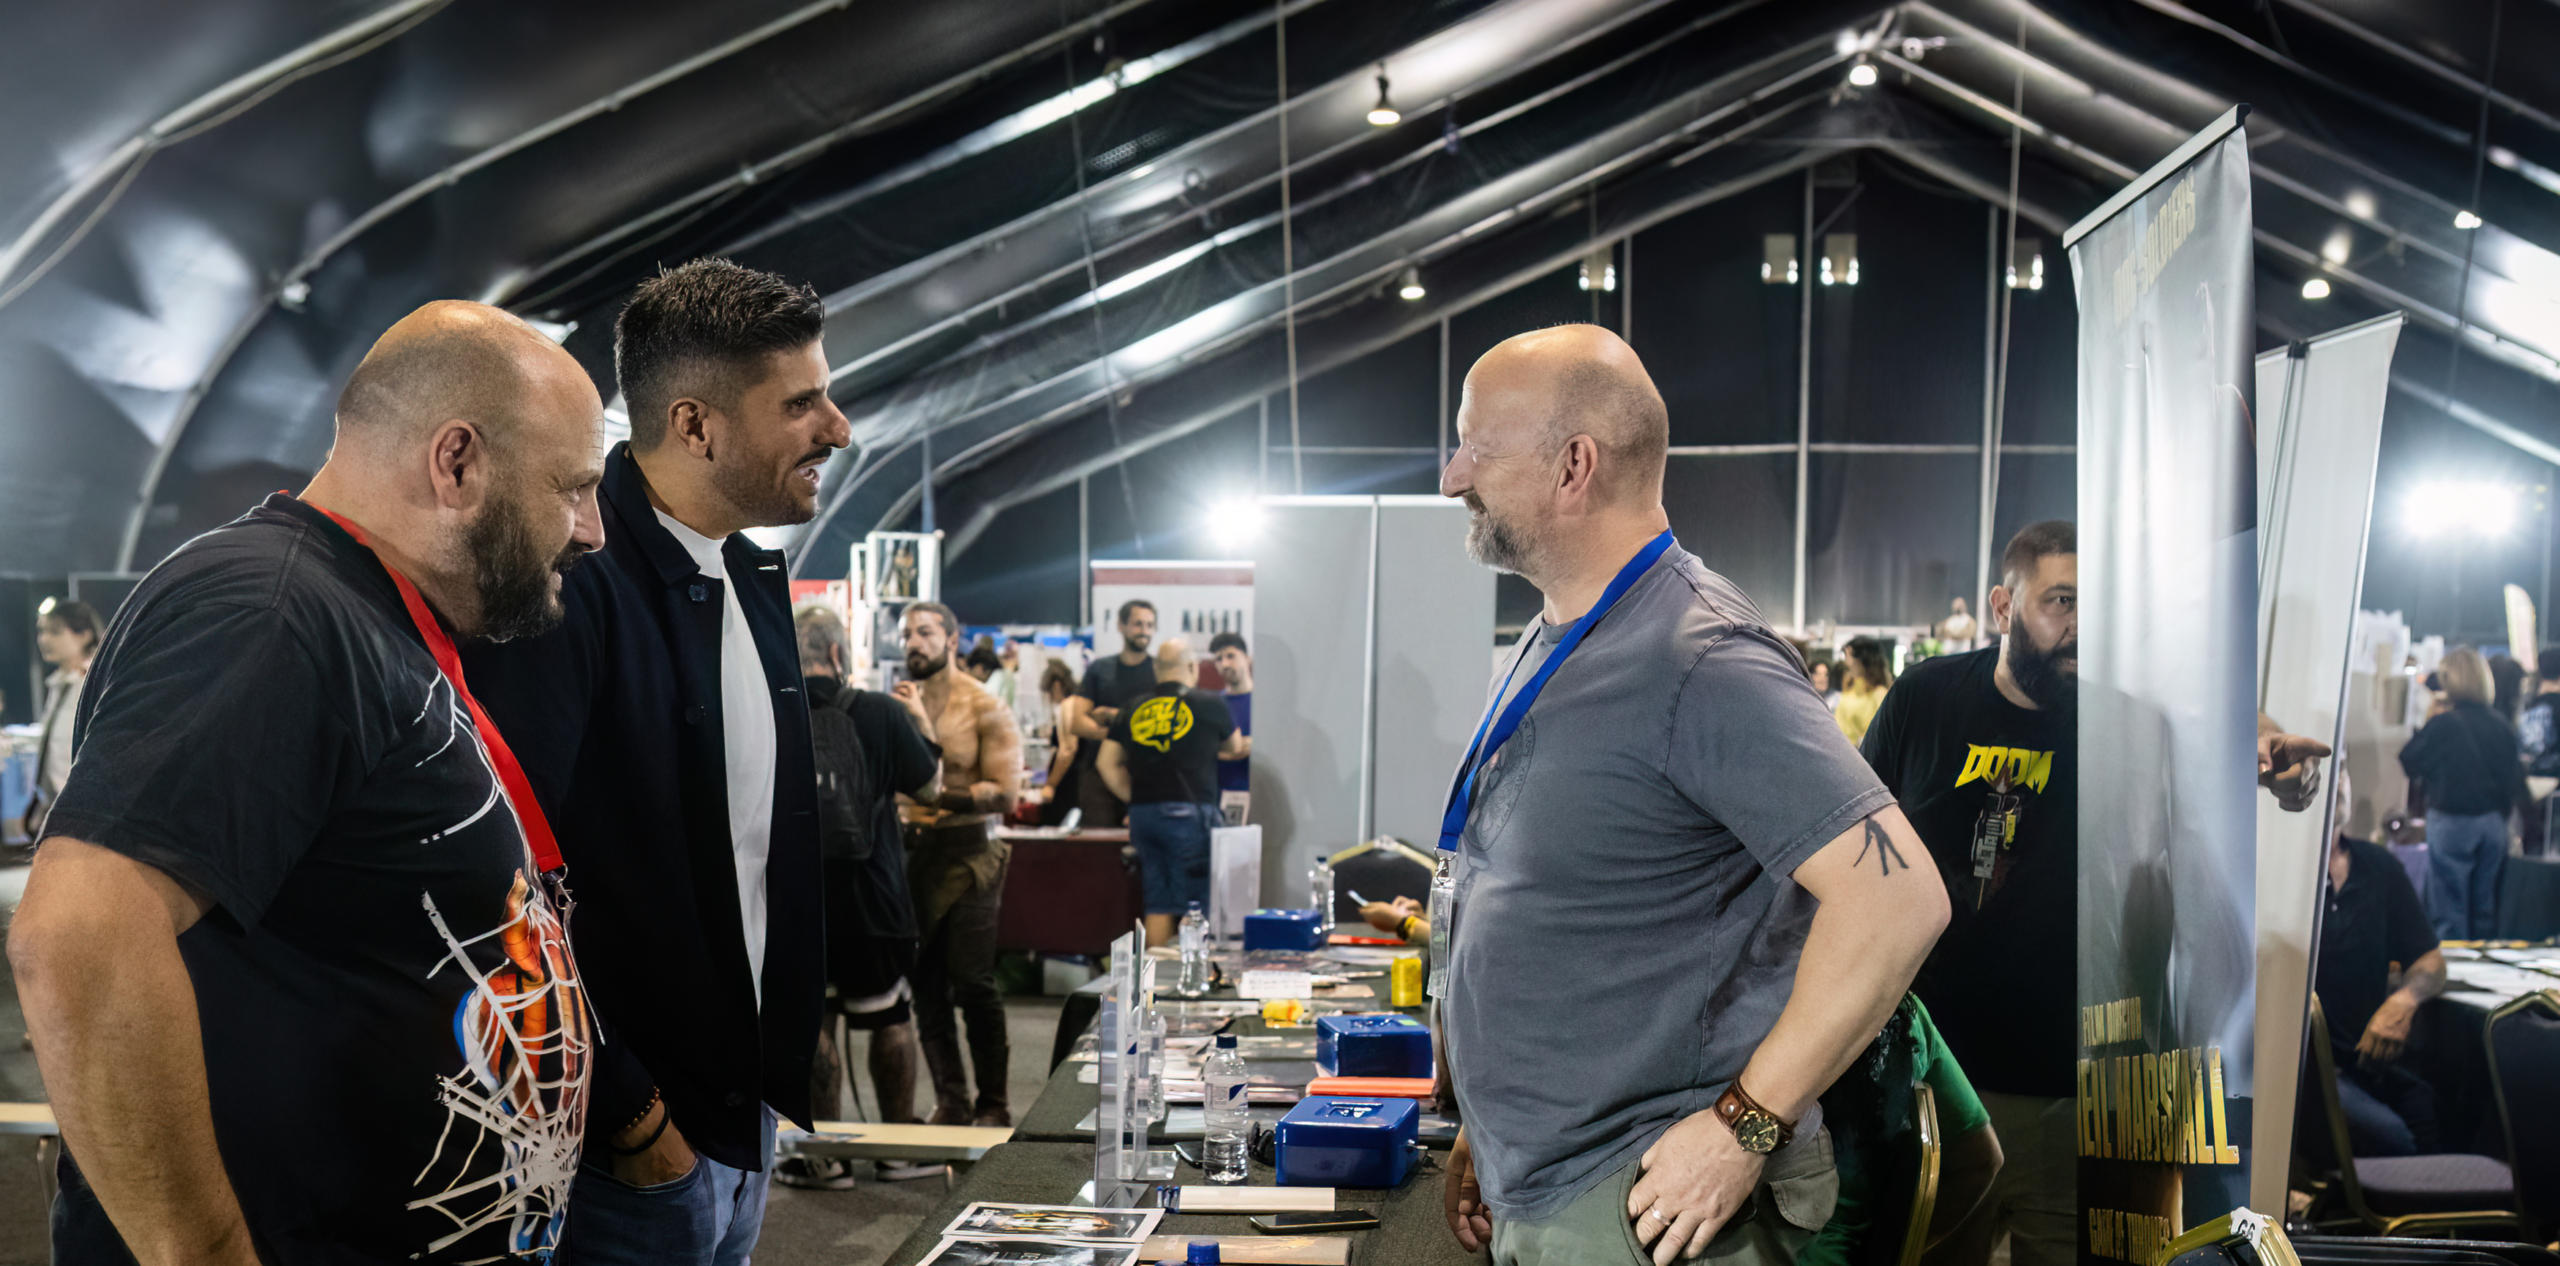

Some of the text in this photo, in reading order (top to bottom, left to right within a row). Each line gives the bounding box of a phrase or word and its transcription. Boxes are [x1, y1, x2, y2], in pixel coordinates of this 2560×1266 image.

[2138, 166, 2196, 297] SOLDIERS
[1954, 742, 2056, 795] DOOM
[2082, 996, 2142, 1047] FILM DIRECTOR
[2115, 1045, 2240, 1165] MARSHALL
